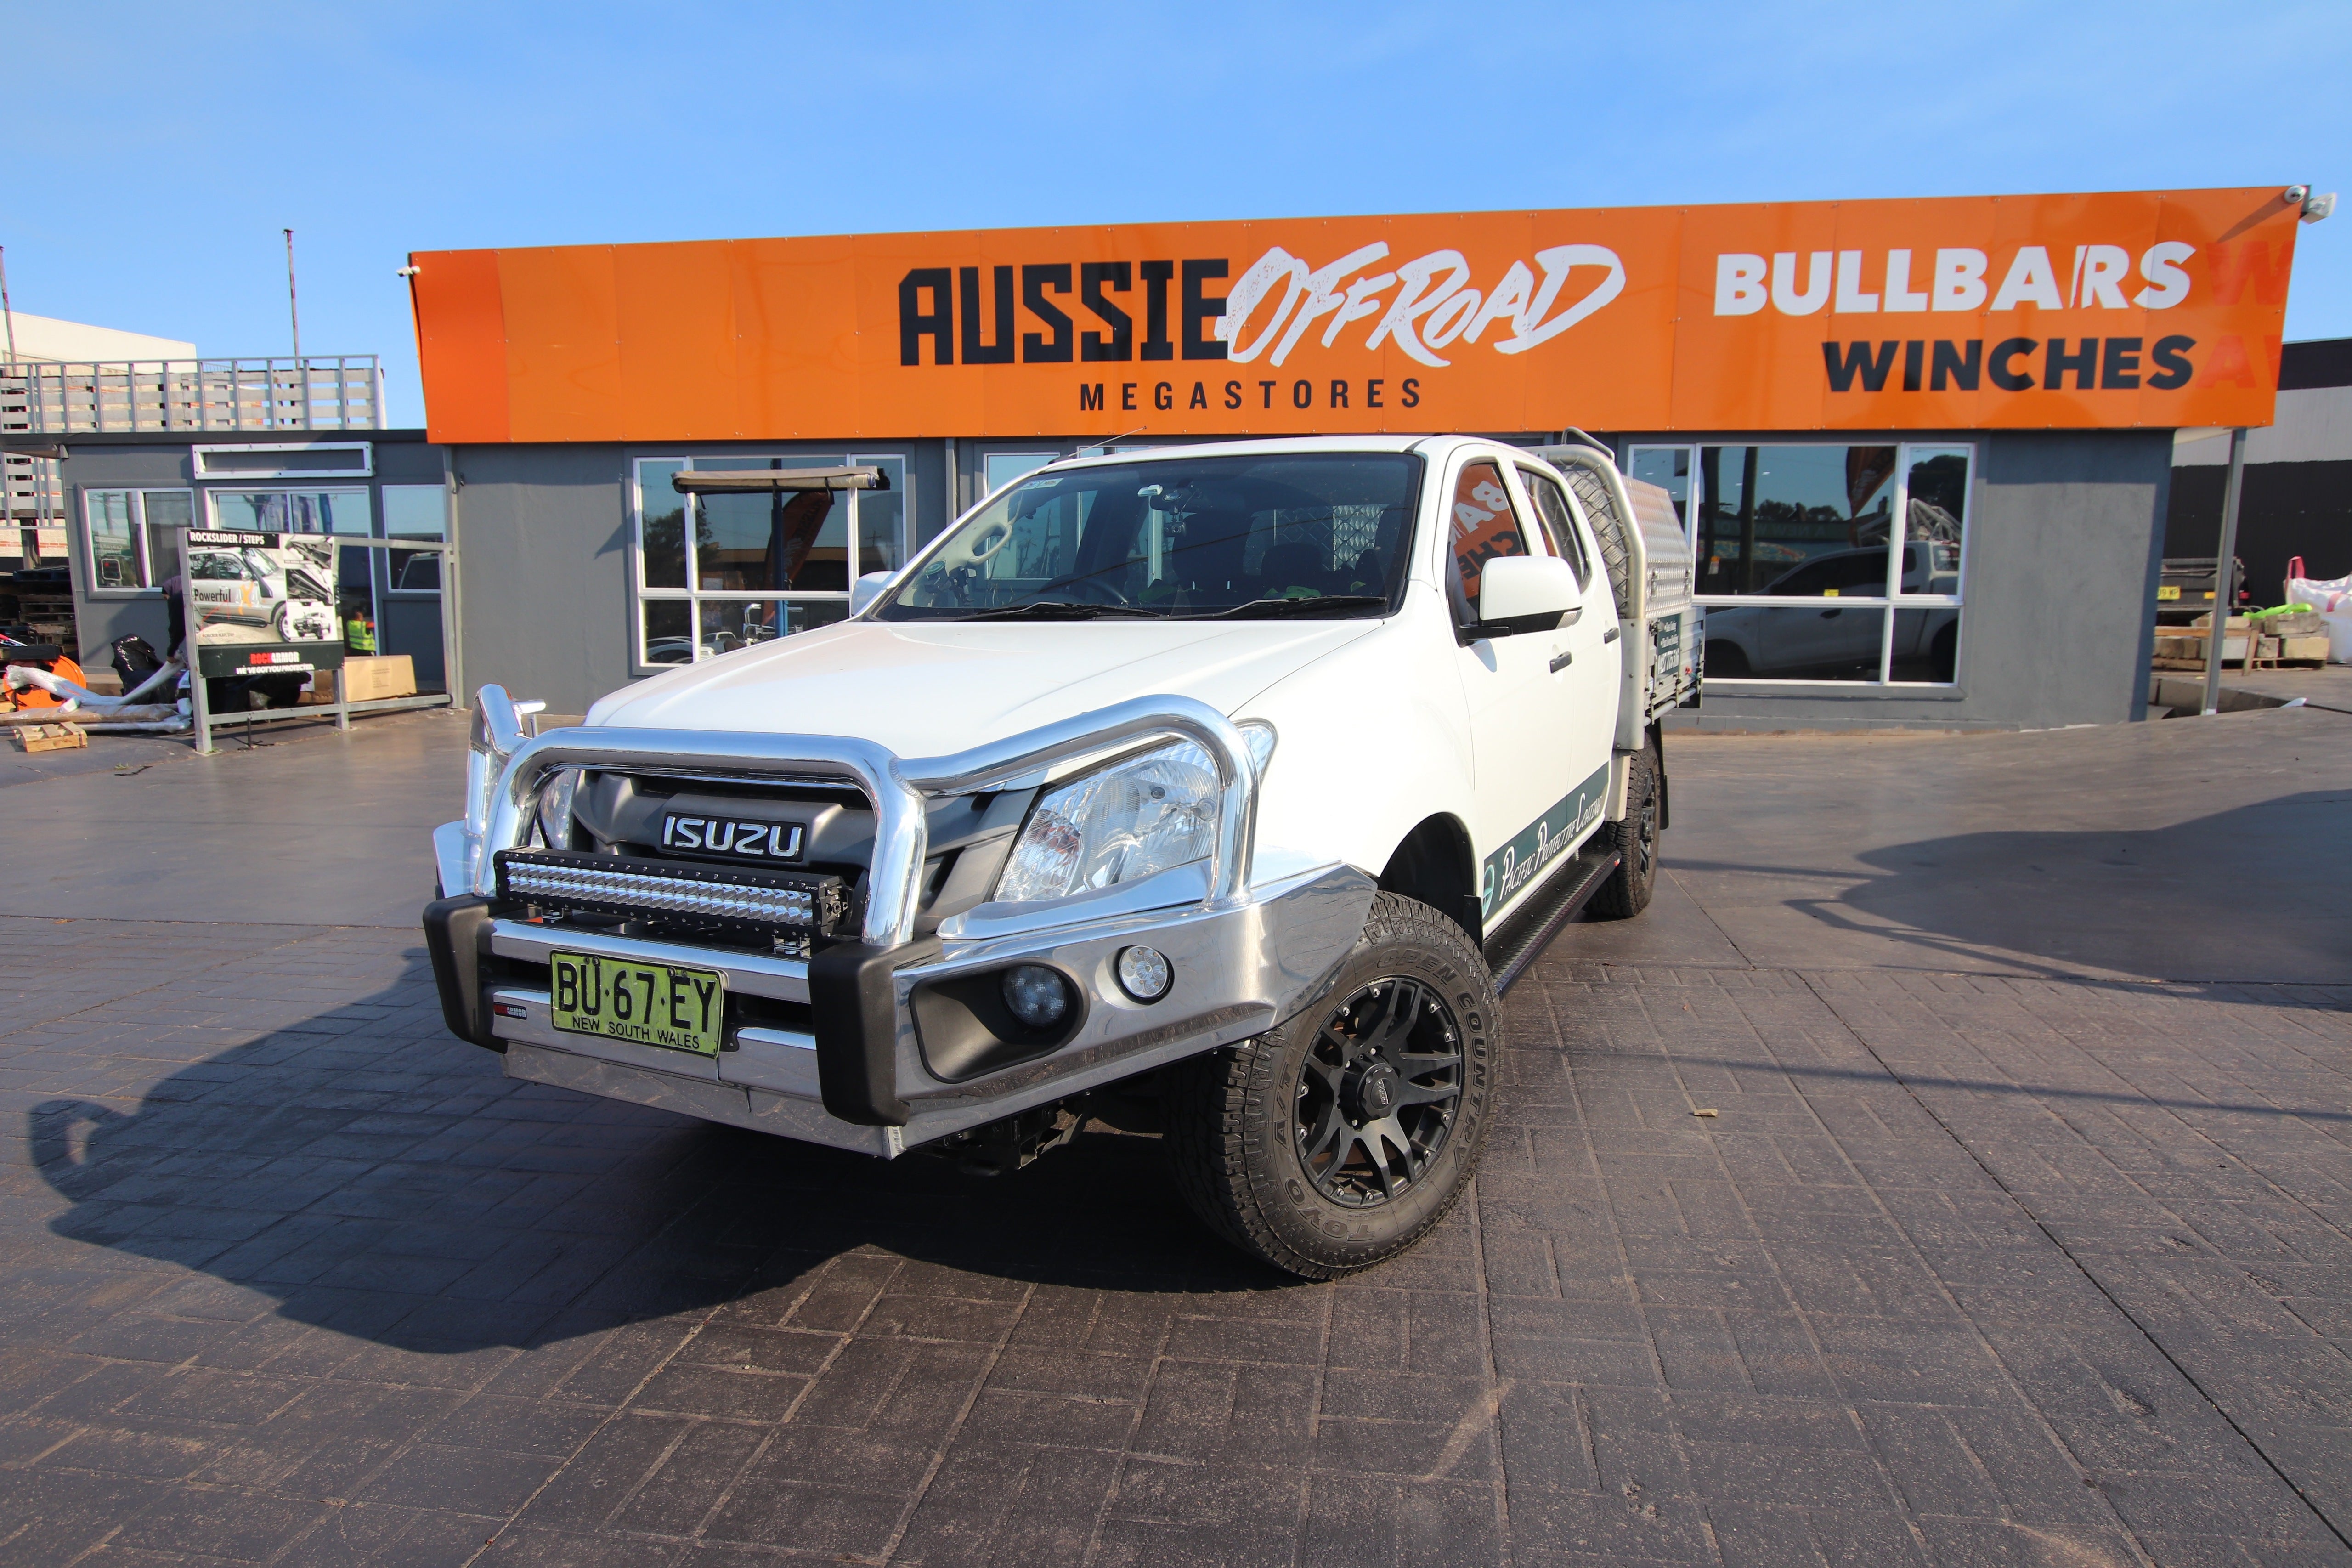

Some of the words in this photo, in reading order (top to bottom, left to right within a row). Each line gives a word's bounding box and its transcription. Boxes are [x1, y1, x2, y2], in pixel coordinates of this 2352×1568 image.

[1713, 242, 2196, 316] BULLBARS
[899, 259, 1229, 366] AUSSIE
[1822, 335, 2197, 392] WINCHES
[1080, 378, 1421, 411] MEGASTORES
[190, 532, 238, 544] ROCKSLIDER
[243, 535, 265, 545] STEPS
[194, 588, 231, 602] Powerful
[664, 816, 802, 857] ISUZU
[573, 1016, 600, 1030] NEW
[609, 1021, 650, 1040] SOUTH
[657, 1030, 700, 1049] WALES
[1377, 948, 1457, 985] OPEN
[1453, 991, 1488, 1171] COUNTRY
[1285, 1178, 1375, 1241] TOYO
